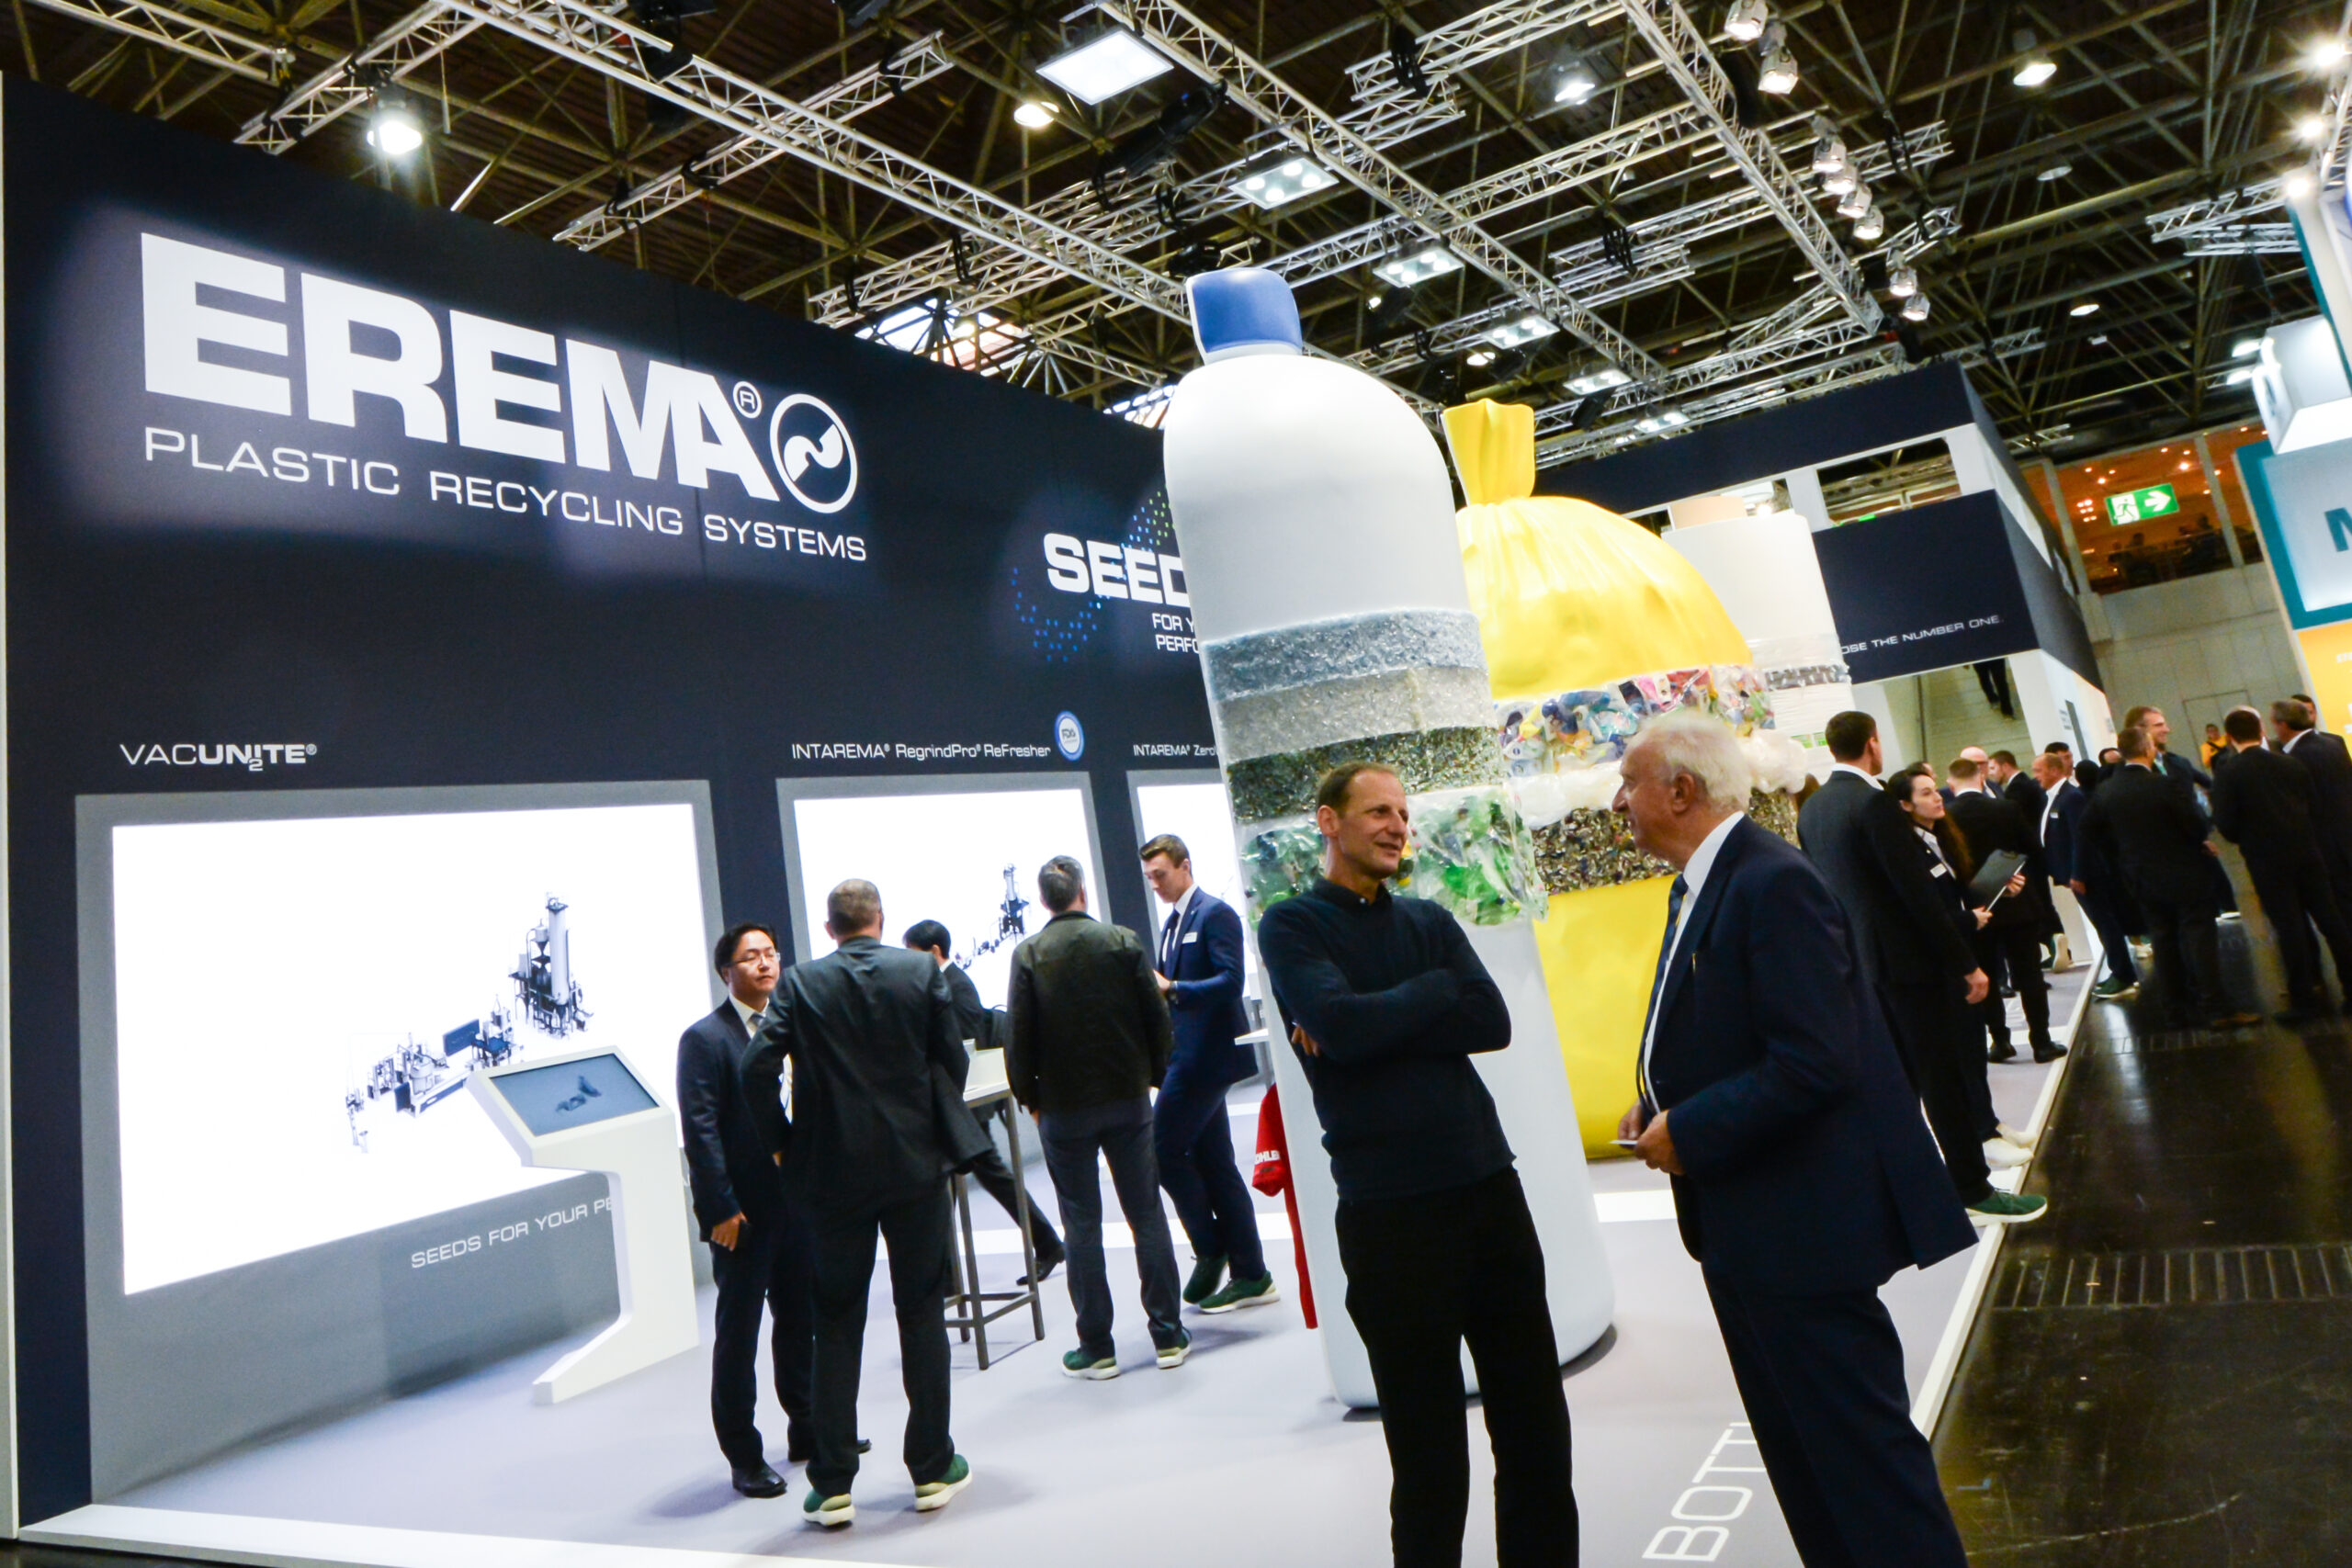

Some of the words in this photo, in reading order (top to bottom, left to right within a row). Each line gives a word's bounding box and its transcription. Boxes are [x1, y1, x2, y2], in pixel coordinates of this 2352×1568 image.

[145, 426, 400, 496] PLASTIC
[430, 471, 684, 536] RECYCLING
[704, 514, 867, 562] SYSTEMS
[1151, 612, 1183, 632] FOR
[1871, 635, 1899, 648] THE
[1902, 622, 1965, 642] NUMBER
[984, 742, 1052, 758] ReFresher
[1193, 744, 1217, 757] Zero
[411, 1235, 482, 1269] SEEDS
[488, 1222, 529, 1247] FOR
[535, 1203, 589, 1232] YOUR
